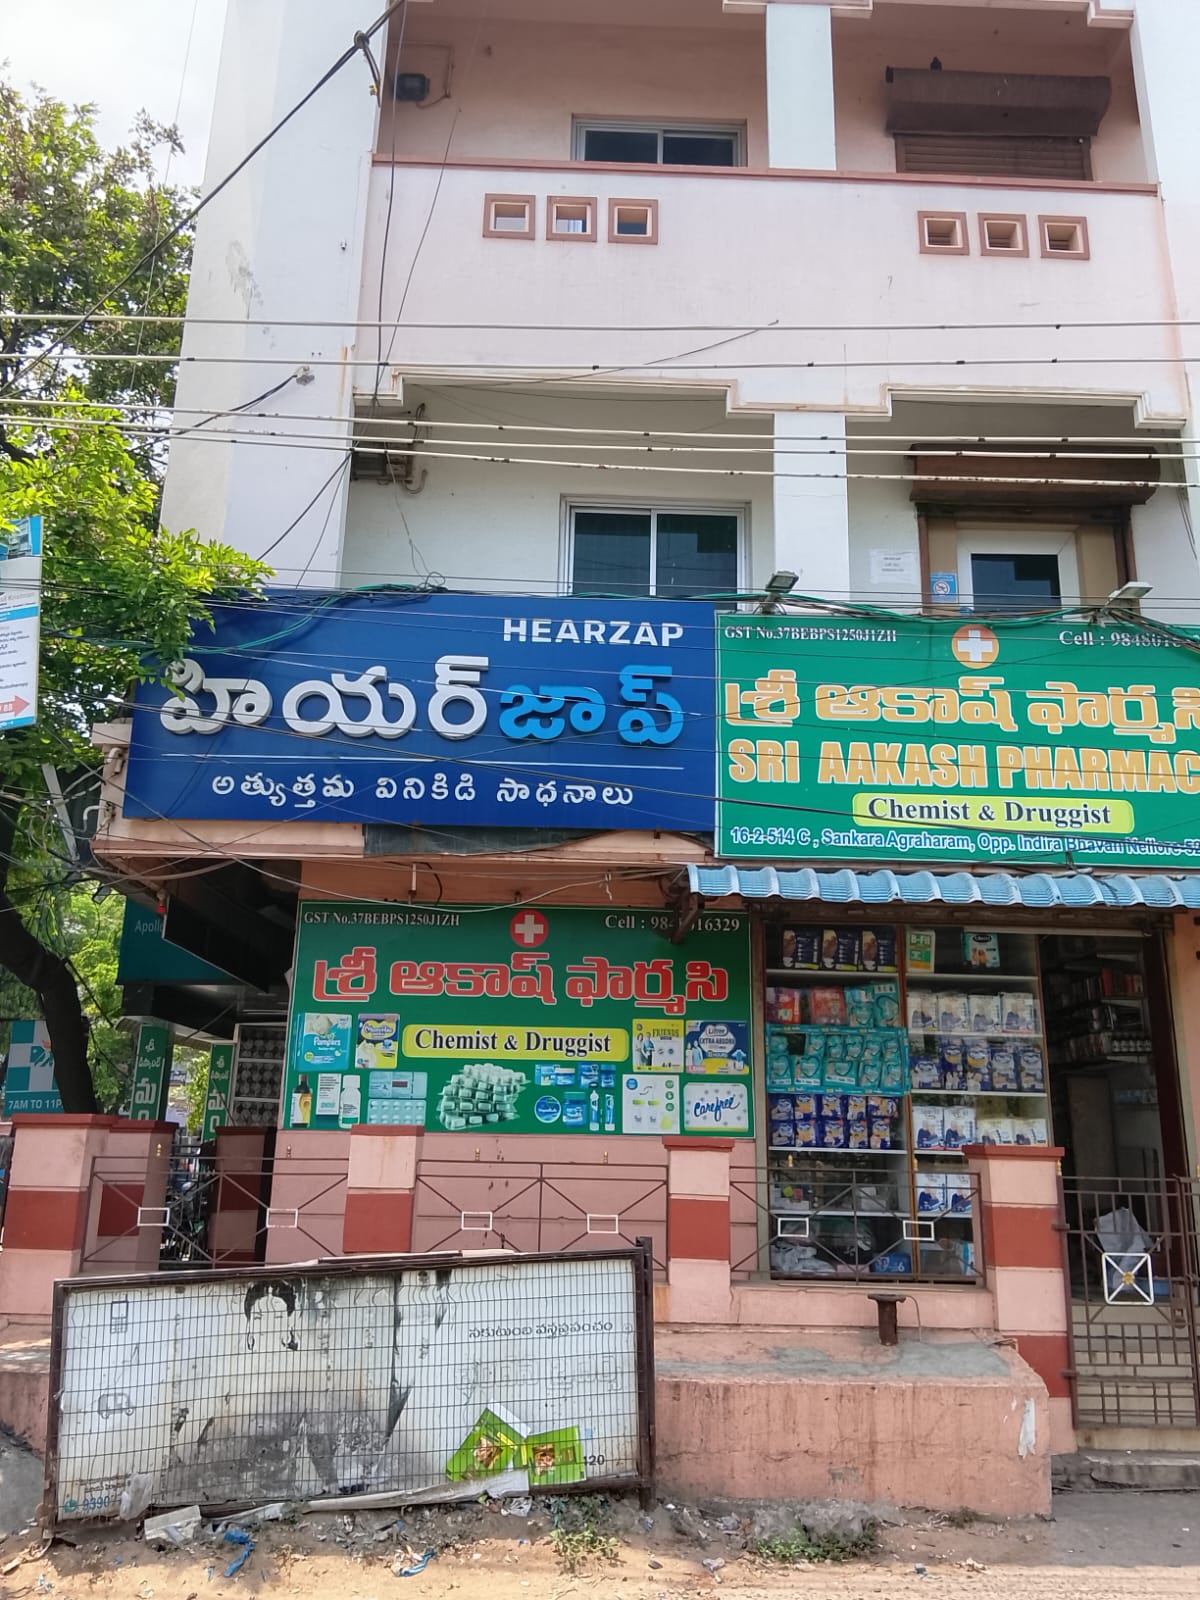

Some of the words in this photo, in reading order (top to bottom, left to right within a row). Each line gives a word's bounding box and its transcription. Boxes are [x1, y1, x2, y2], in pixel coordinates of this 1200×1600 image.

[503, 617, 685, 647] HEARZAP
[724, 626, 752, 639] GST
[1059, 630, 1094, 646] Cell
[815, 676, 1019, 732] ఆకాష్
[728, 739, 801, 783] SRI
[818, 741, 989, 788] AAKASH
[375, 773, 476, 802] వినికిడి
[496, 777, 634, 807] సాధనాలు
[868, 797, 970, 822] Chemist
[978, 805, 996, 821] &
[1003, 801, 1112, 828] Druggist
[821, 829, 884, 847] Sankara
[886, 831, 975, 852] Agraharam,
[977, 832, 1015, 854] Opp.
[1017, 834, 1062, 852] Indira
[304, 912, 330, 924] GST
[605, 914, 636, 929] Cell
[389, 951, 558, 1005] ఆకాష్
[415, 1028, 499, 1051] Chemist
[503, 1034, 519, 1051] &
[525, 1030, 612, 1057] Druggist
[8, 1099, 29, 1110] 7AM
[30, 1099, 43, 1109] TO
[693, 1095, 740, 1122] Carefree
